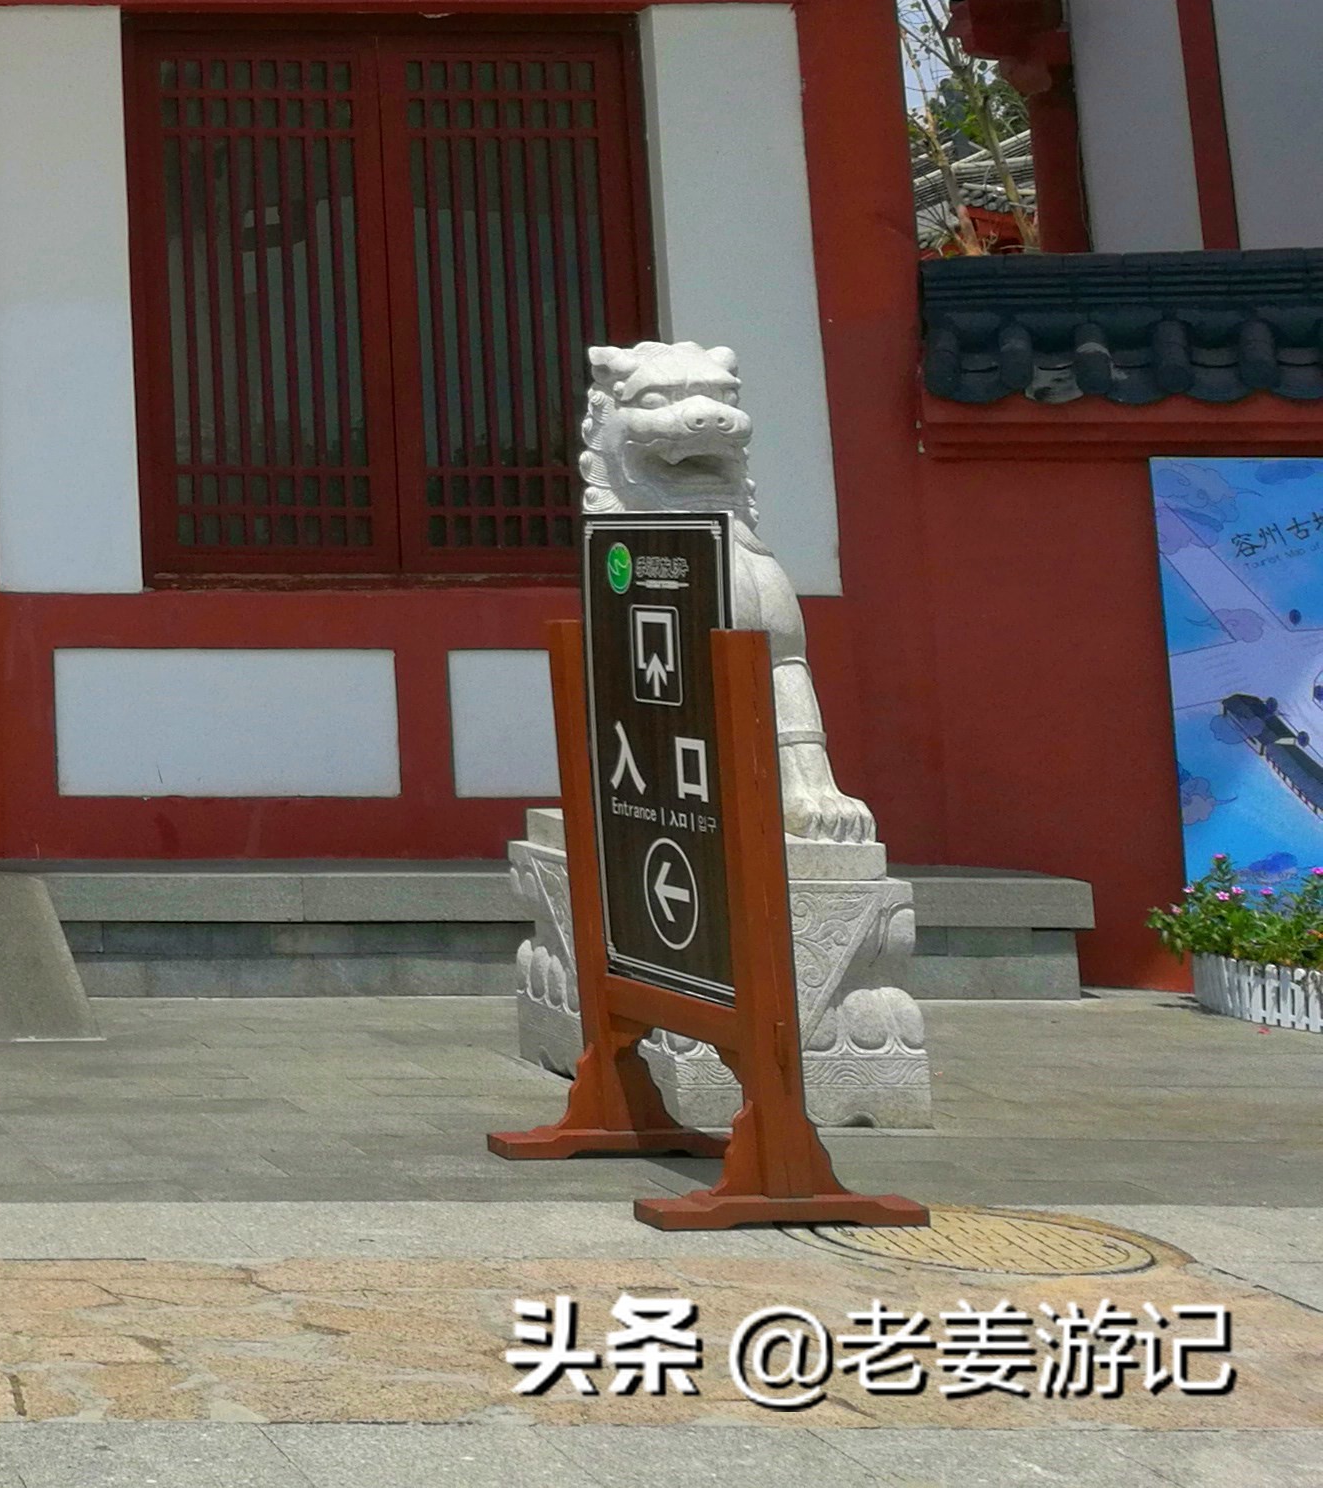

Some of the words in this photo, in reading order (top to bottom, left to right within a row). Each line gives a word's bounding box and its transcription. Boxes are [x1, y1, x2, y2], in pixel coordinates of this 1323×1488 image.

[610, 720, 709, 804] 入口
[611, 796, 658, 822] Entrance
[669, 810, 689, 829] 入口
